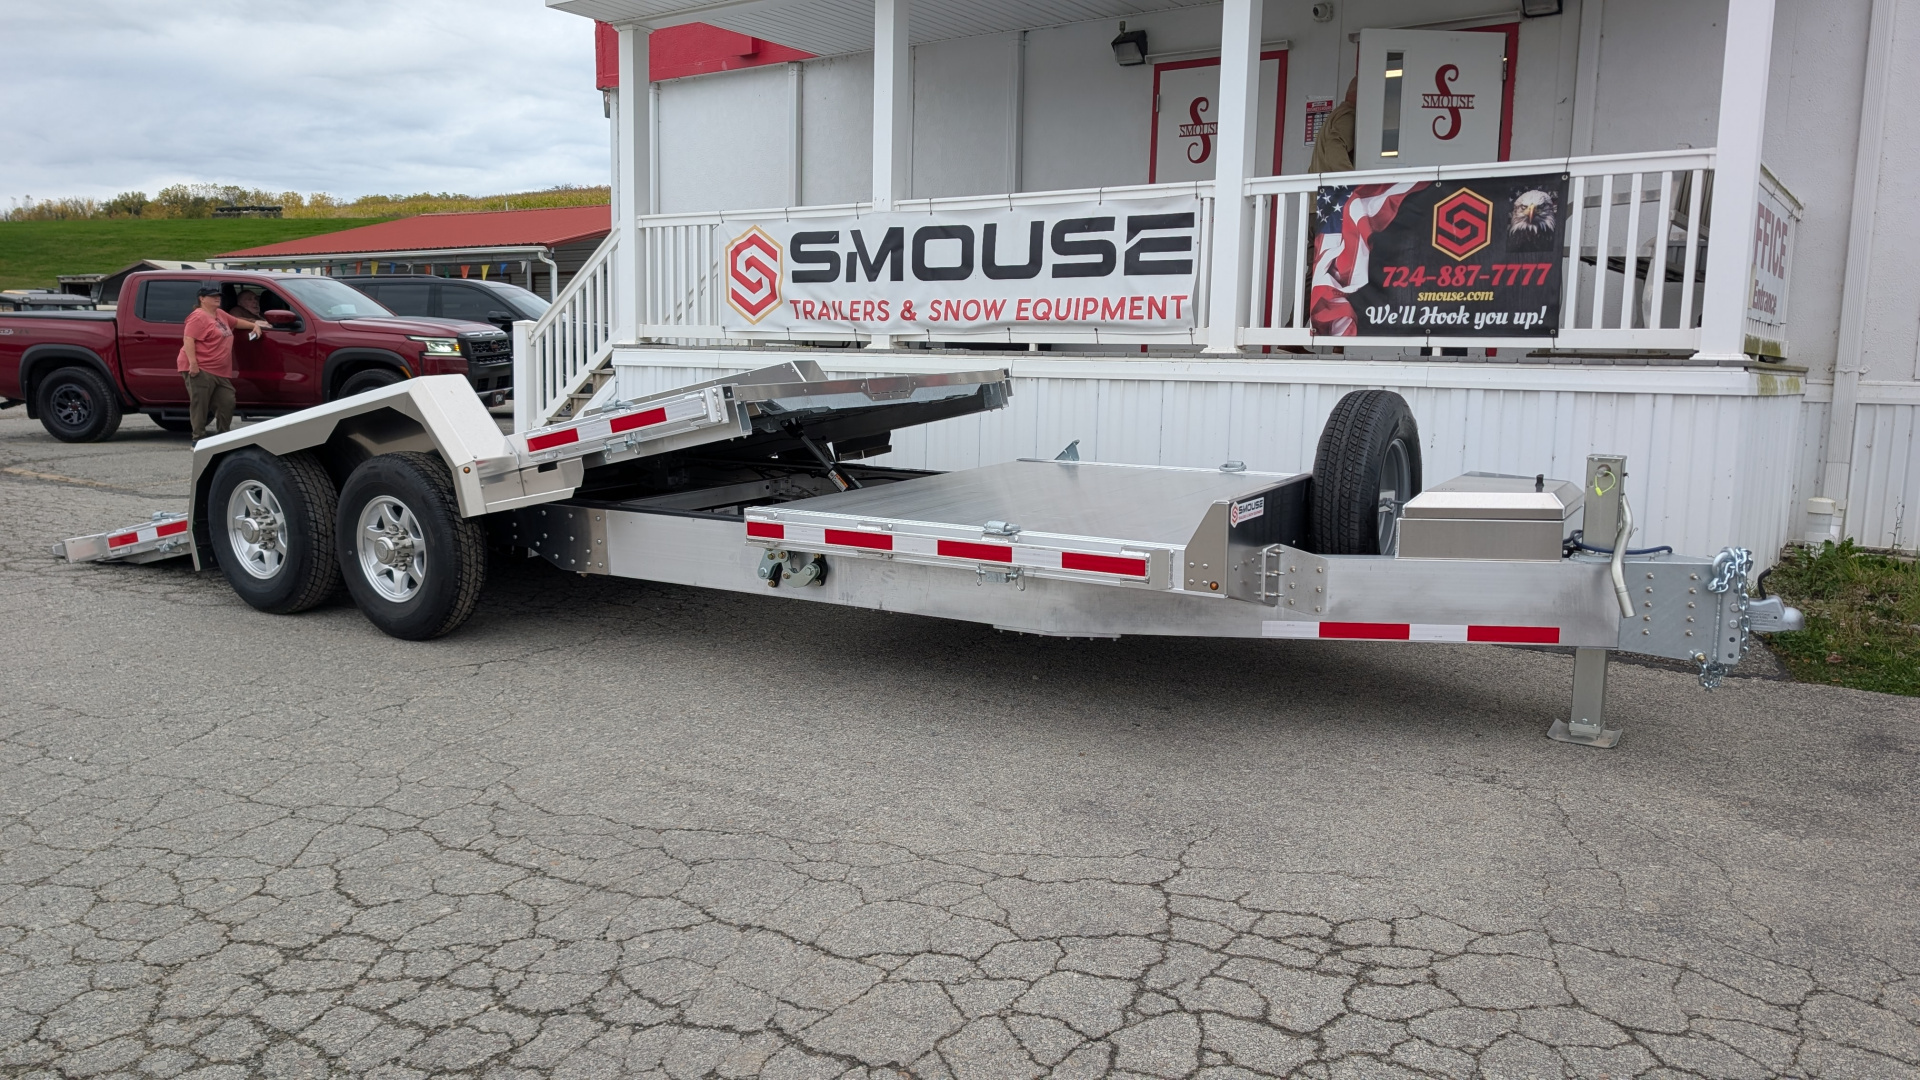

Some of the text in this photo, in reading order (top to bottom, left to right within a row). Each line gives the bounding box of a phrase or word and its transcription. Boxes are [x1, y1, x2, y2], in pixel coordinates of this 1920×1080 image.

[1422, 94, 1475, 109] SMOUSE
[789, 212, 1195, 283] SMOUSE
[1753, 201, 1788, 280] FFICE
[1382, 263, 1553, 288] 724-887-7777
[789, 295, 1188, 321] TRAILERS & SNOW EQUIPMENT
[1417, 291, 1494, 301] smouse.com
[1365, 304, 1548, 330] We'll Hook you up!
[1238, 499, 1264, 515] SMOUSE
